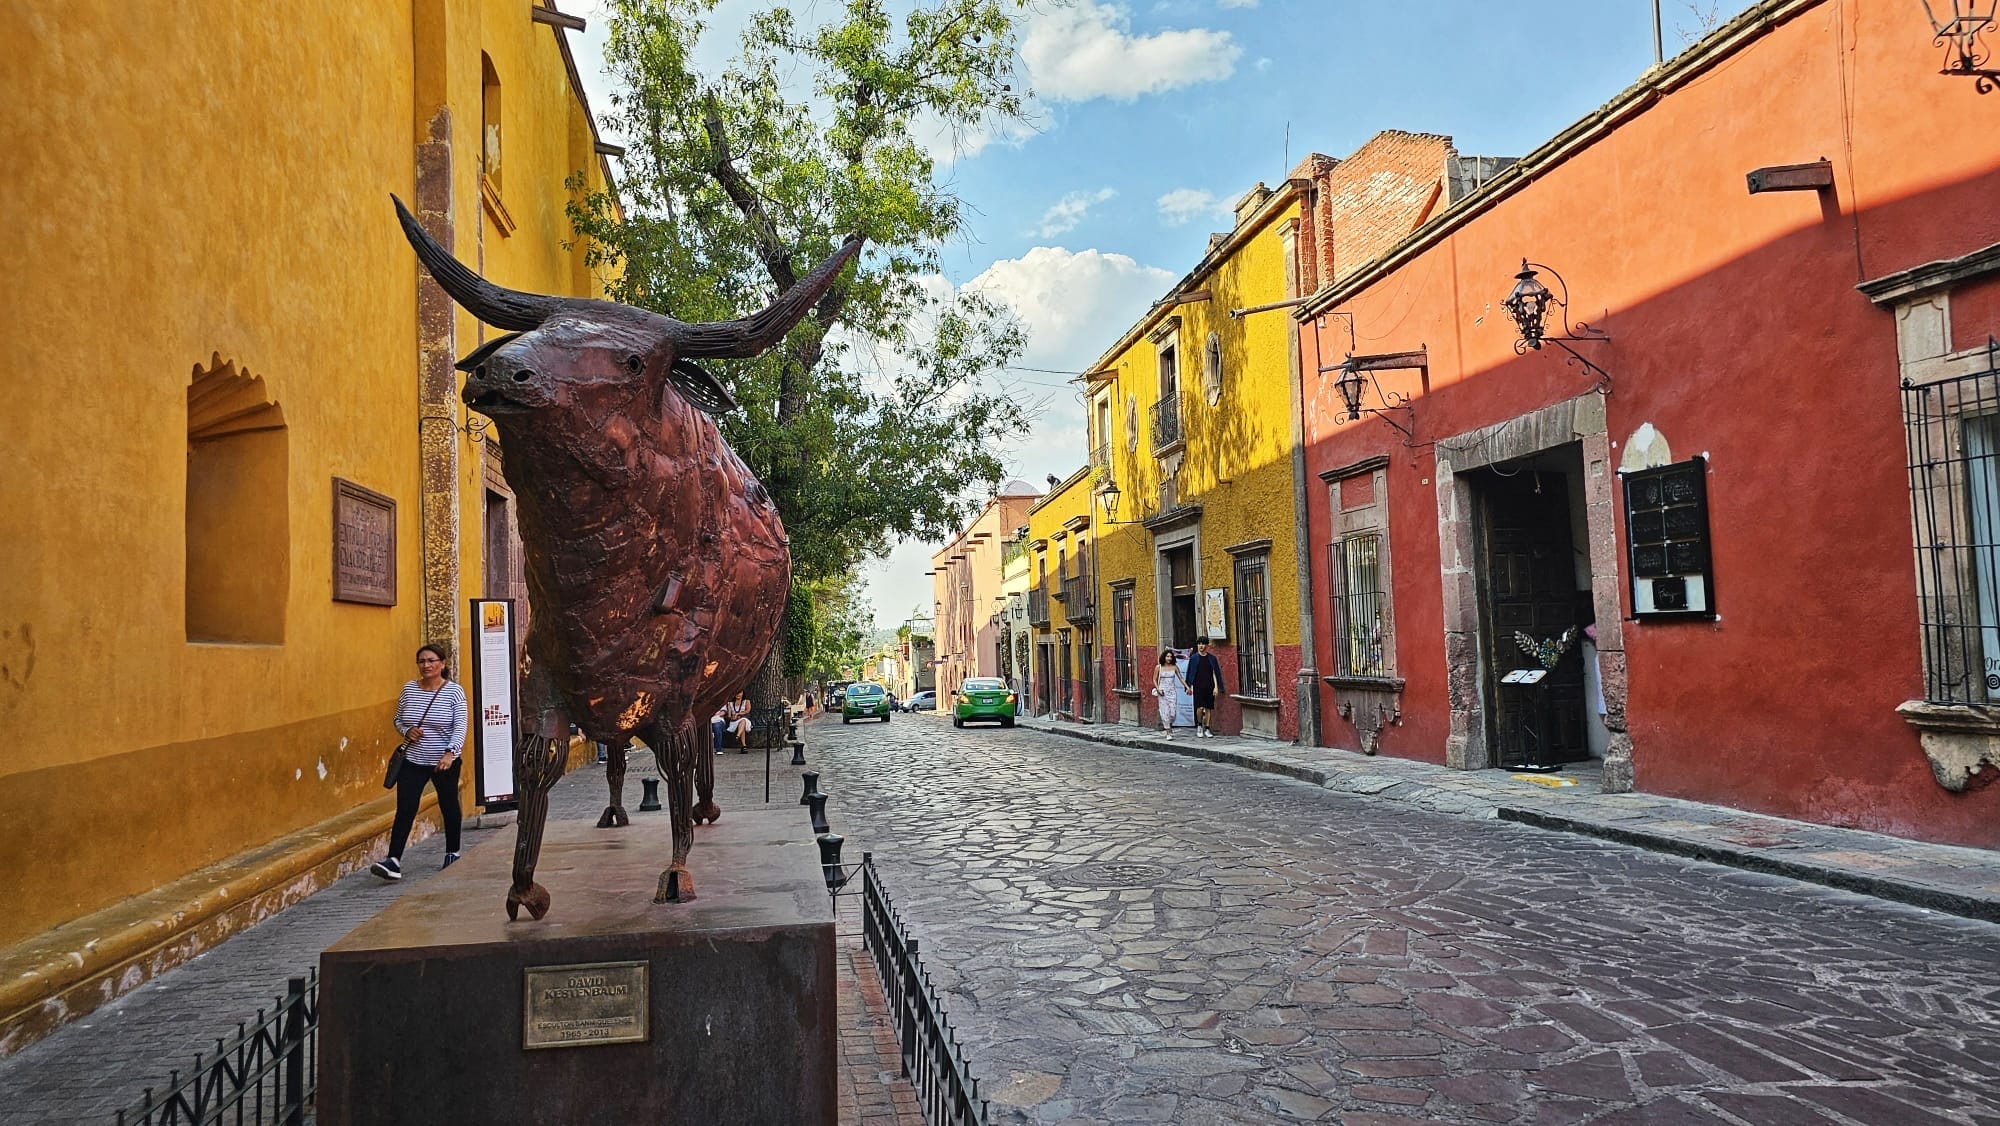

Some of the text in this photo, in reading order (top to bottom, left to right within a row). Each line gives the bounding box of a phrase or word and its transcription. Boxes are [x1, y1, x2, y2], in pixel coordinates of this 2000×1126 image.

[567, 975, 606, 989] DAVID
[544, 984, 628, 1000] KESTENBAUM
[561, 1029, 582, 1039] 1965
[589, 1028, 610, 1038] 2013
